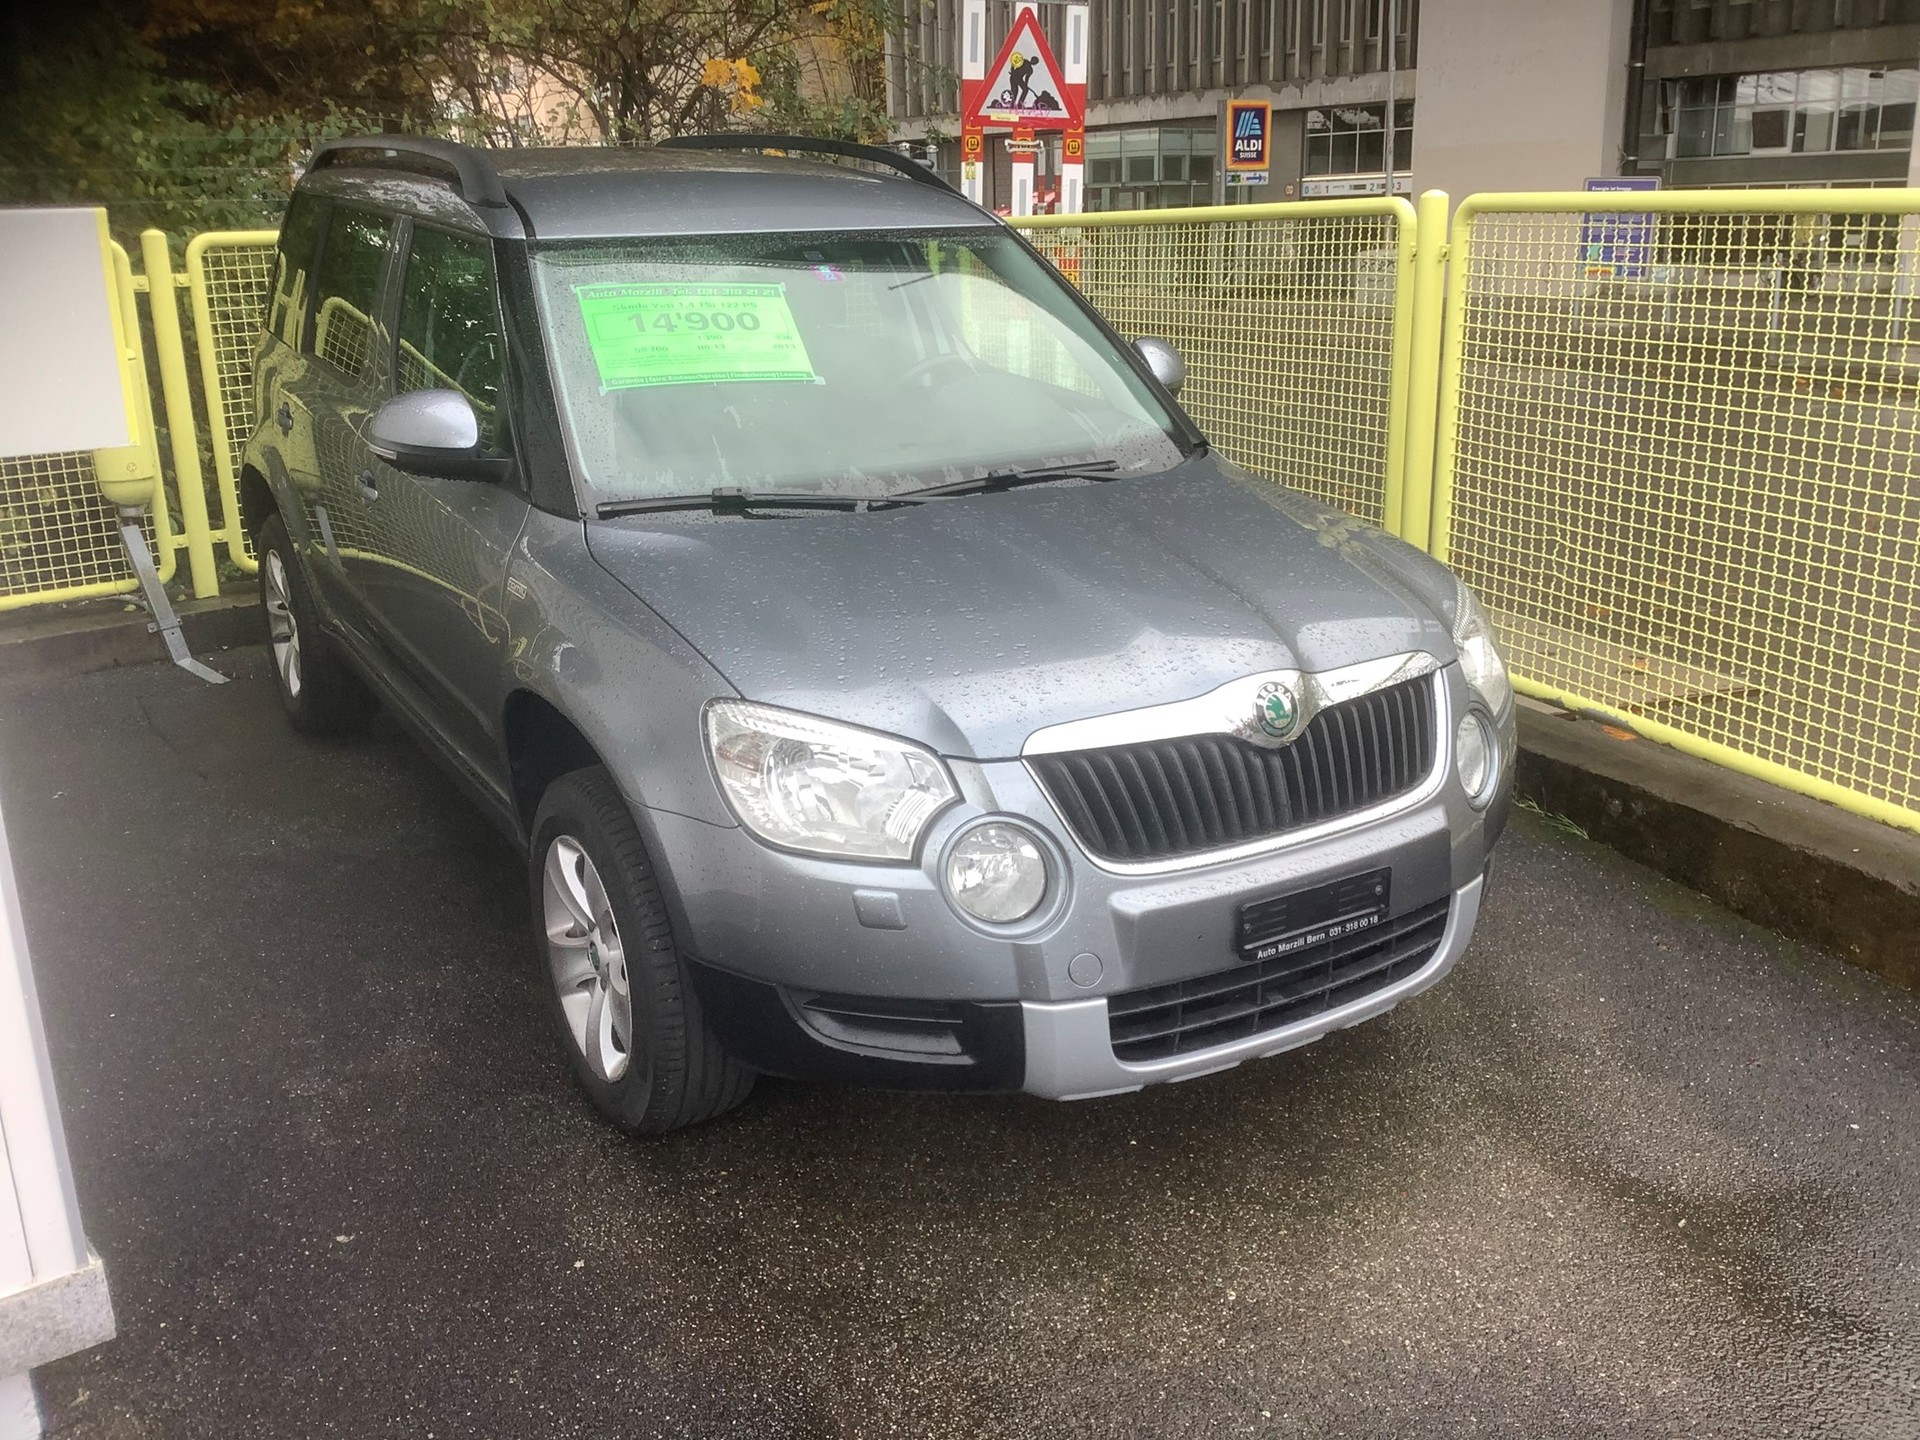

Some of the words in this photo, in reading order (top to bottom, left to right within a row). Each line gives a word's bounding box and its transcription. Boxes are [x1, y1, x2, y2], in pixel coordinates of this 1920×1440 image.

[1235, 139, 1262, 151] ALDI
[587, 290, 617, 299] Auto
[627, 311, 761, 333] 14'900
[1257, 948, 1277, 959] Auto
[1278, 938, 1305, 953] Marzili
[1306, 932, 1326, 944] Bern
[1359, 918, 1369, 928] 00
[1370, 915, 1379, 925] 18
